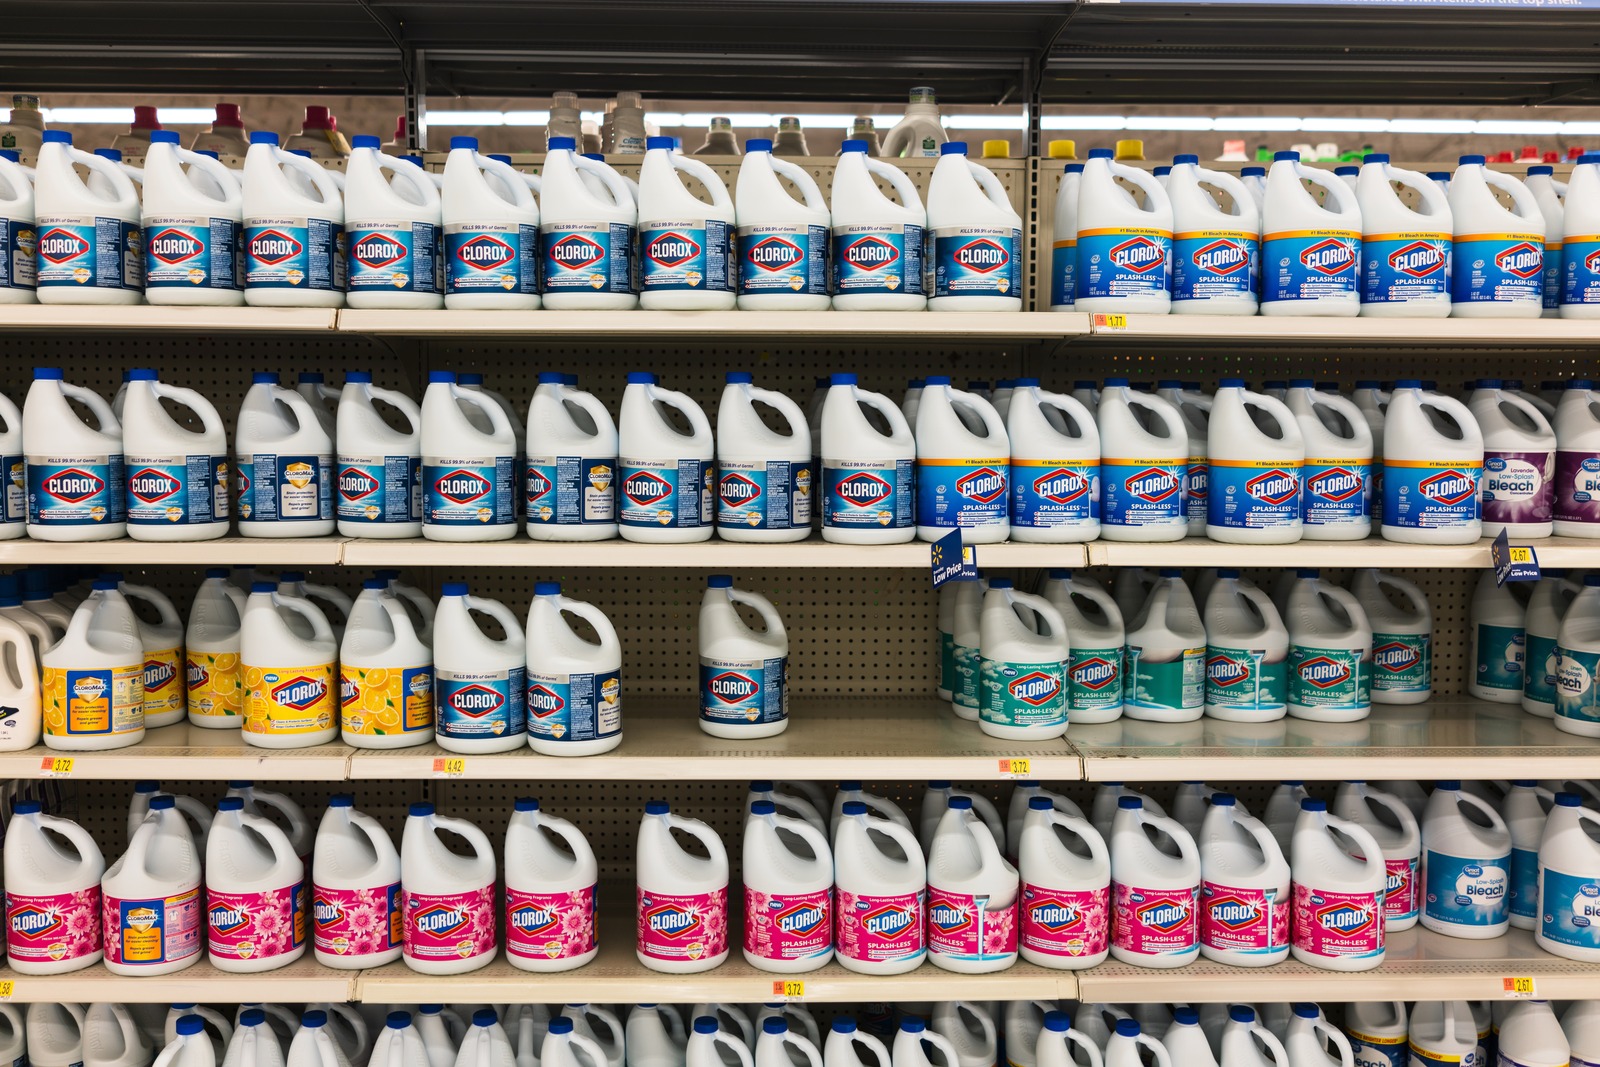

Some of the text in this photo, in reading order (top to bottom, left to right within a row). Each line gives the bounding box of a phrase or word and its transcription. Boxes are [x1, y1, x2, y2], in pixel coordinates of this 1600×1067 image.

[41, 239, 80, 254] CLOROX
[153, 239, 195, 254] CLOROX
[252, 240, 294, 255] CLOROX
[357, 244, 398, 258] CLOROX
[463, 245, 507, 260] CLOROX
[554, 245, 597, 260] CLOROX
[651, 243, 692, 258] CLOROX
[848, 247, 891, 261] CLOROX
[753, 247, 796, 262] CLOROX
[960, 249, 1003, 264] CLOROX
[1115, 245, 1162, 268] CLOROX
[1199, 246, 1246, 269] CLOROX
[1306, 247, 1353, 269] CLOROX
[1394, 249, 1441, 271] CLOROX
[1501, 250, 1542, 272] CLOROX
[1115, 273, 1157, 282] SPLASH-LESS
[1110, 316, 1123, 326] 1.77
[49, 479, 97, 494] CLOROX
[131, 479, 172, 494] CLOROX
[339, 477, 371, 492] CLOROX
[440, 480, 483, 494] CLOROX
[626, 482, 664, 496] CLOROX
[720, 484, 753, 498] CLOROX
[841, 482, 884, 497] CLOROX
[961, 474, 1003, 497] CLOROX
[1038, 474, 1085, 498] CLOROX
[1130, 474, 1175, 496] CLOROX
[1251, 476, 1297, 499] CLOROX
[1312, 474, 1359, 496] CLOROX
[1425, 475, 1472, 498] CLOROX
[1488, 479, 1534, 491] Bleach
[1513, 550, 1526, 561] 2.67
[933, 570, 946, 585] Low
[946, 562, 962, 577] Price
[1374, 649, 1415, 666] CLOROX
[1073, 662, 1115, 682] CLOROX
[1207, 662, 1243, 677] CLOROX
[1301, 661, 1345, 680] CLOROX
[277, 681, 323, 705] CLOROX
[712, 680, 752, 695] CLOROX
[1014, 677, 1058, 700] CLOROX
[1301, 688, 1343, 697] SPLASH-LESS
[454, 694, 497, 708] CLOROX
[1014, 707, 1056, 715] SPLASH-LESS
[55, 760, 70, 771] 3.72
[448, 761, 461, 771] 4.42
[1013, 761, 1027, 772] 3.72
[1466, 884, 1504, 896] Bleach
[209, 907, 245, 926] CLOROX
[314, 904, 339, 920] LOROX
[511, 908, 552, 928] CLOROX
[780, 906, 824, 932] CLOROX
[930, 905, 967, 924] CLOROX
[1031, 905, 1077, 924] CLOROX
[1140, 903, 1187, 926] CLOROX
[1211, 903, 1256, 920] CLOROX
[1321, 906, 1369, 929] CLOROX
[12, 909, 56, 931] CLOROX
[417, 908, 464, 932] CLOROX
[649, 909, 694, 930] CLOROX
[867, 907, 914, 934] CLOROX
[780, 937, 824, 947] SPLASH-LESS
[1141, 934, 1185, 942] SPLASH-LESS
[1211, 929, 1255, 941] SPLASH-LESS
[1322, 937, 1368, 945] SPLASH-LESS
[867, 940, 912, 949] SPLASH-LESS
[788, 983, 801, 996] 3.72
[1517, 980, 1529, 991] 2.67
